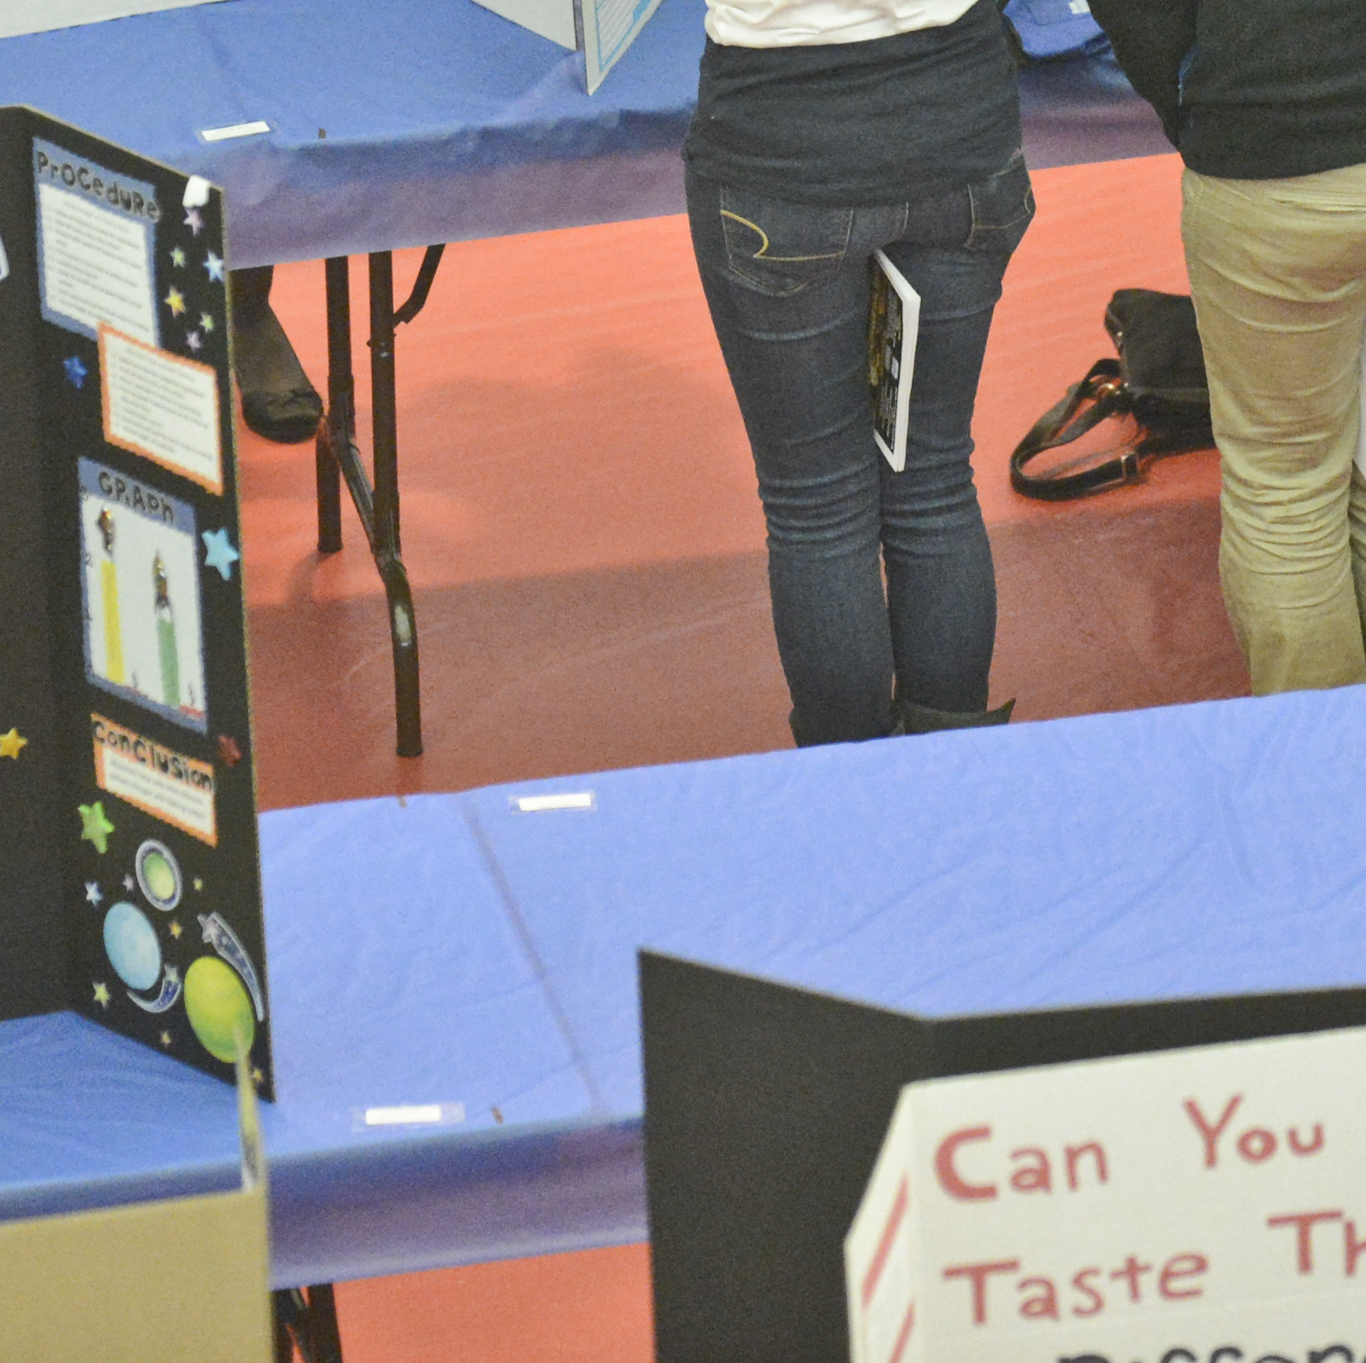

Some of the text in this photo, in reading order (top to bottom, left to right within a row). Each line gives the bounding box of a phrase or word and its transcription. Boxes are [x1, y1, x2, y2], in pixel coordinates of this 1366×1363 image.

[934, 1094, 1325, 1204] Can You
[943, 1250, 1210, 1327] Taste
